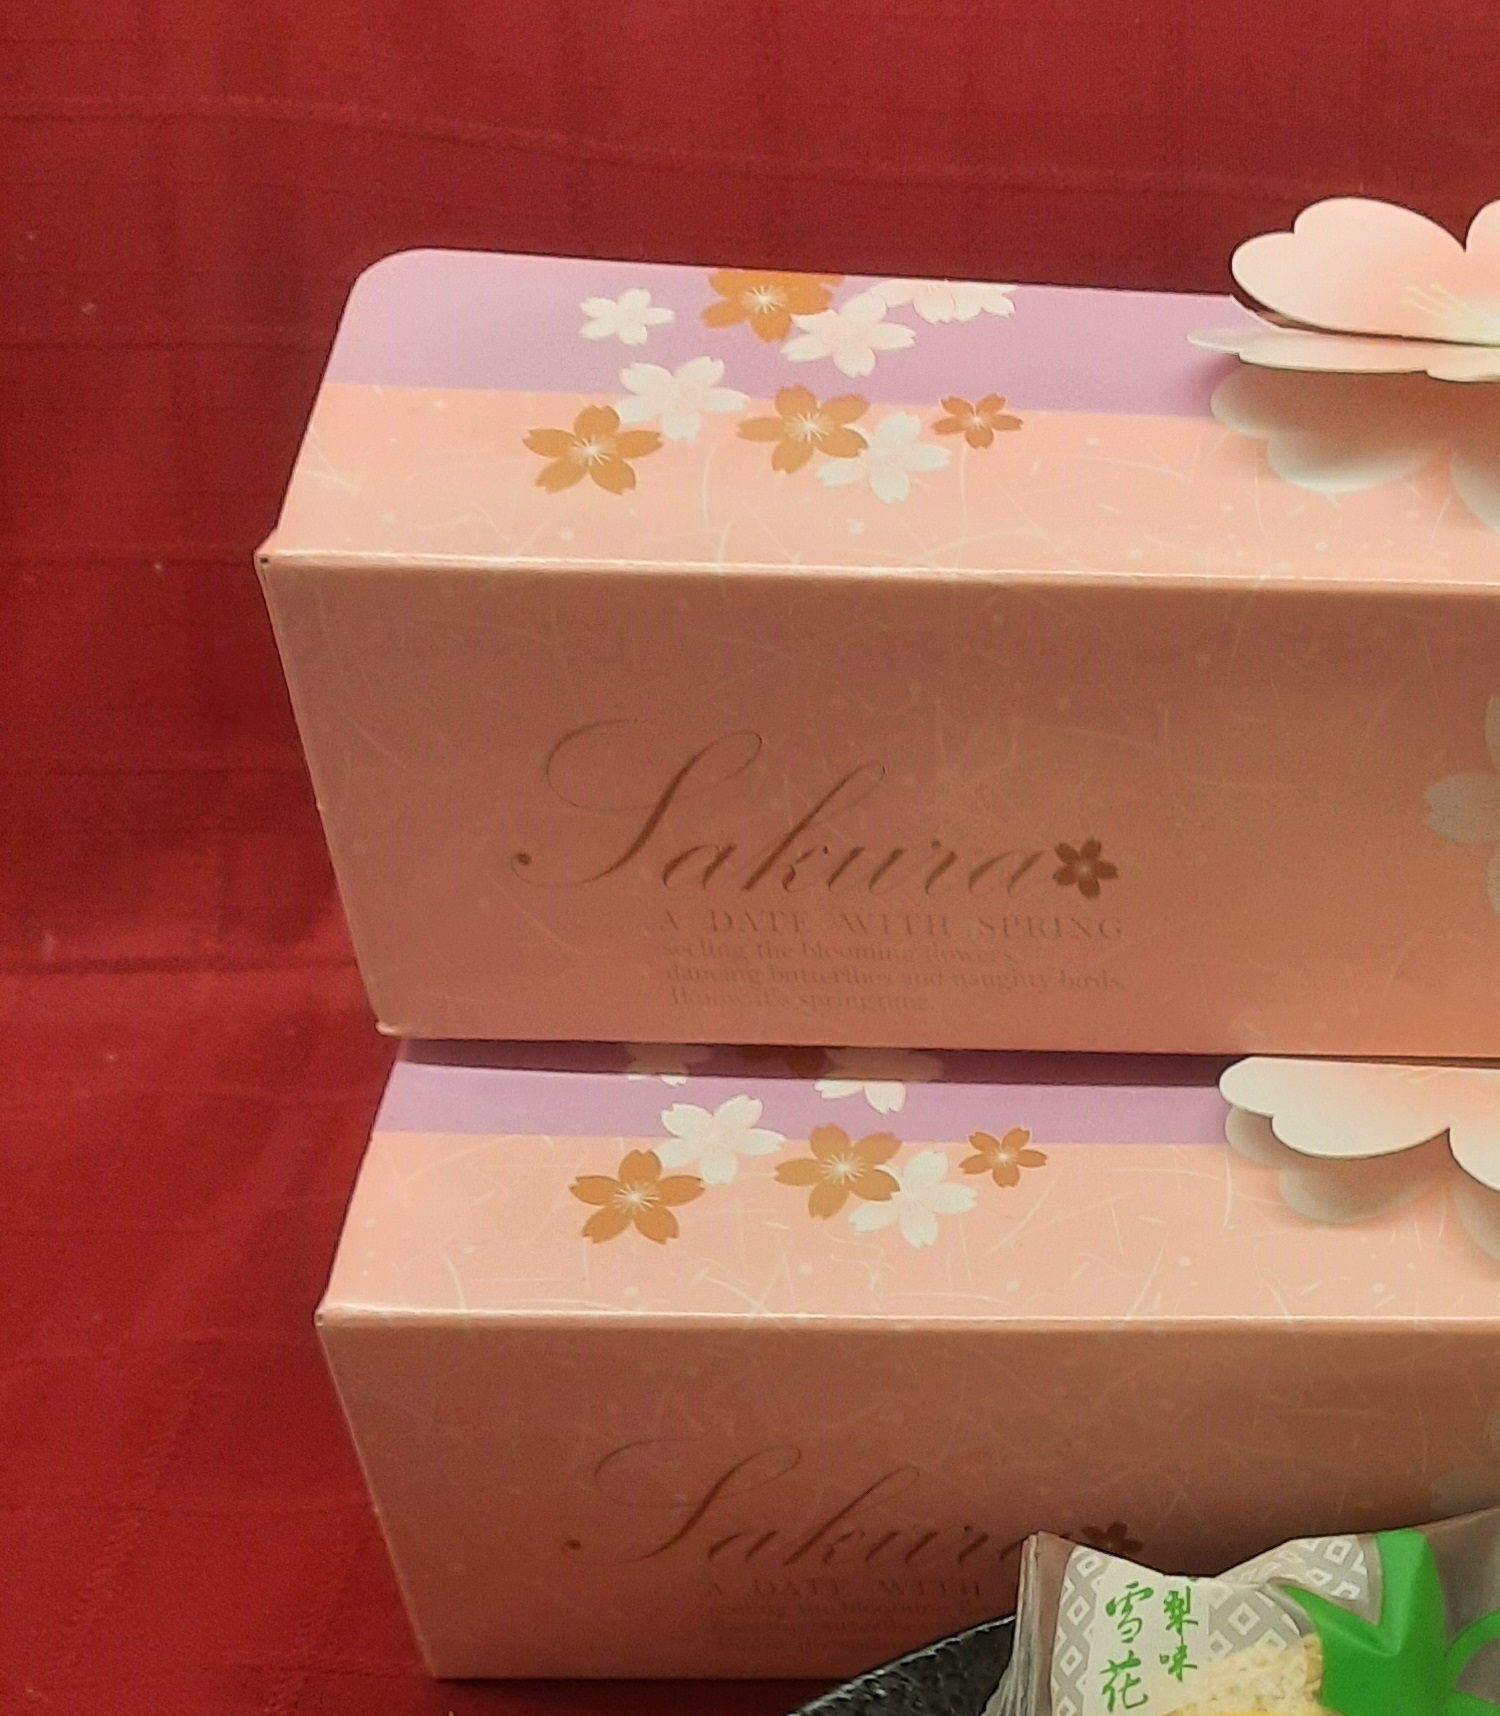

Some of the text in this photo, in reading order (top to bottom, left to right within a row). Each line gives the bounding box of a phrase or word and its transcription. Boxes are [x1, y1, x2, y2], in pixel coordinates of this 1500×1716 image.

[511, 718, 1045, 893] Sakura
[659, 908, 1123, 941] A DATE WITH SPRING
[1159, 1578, 1200, 1682] 梨味
